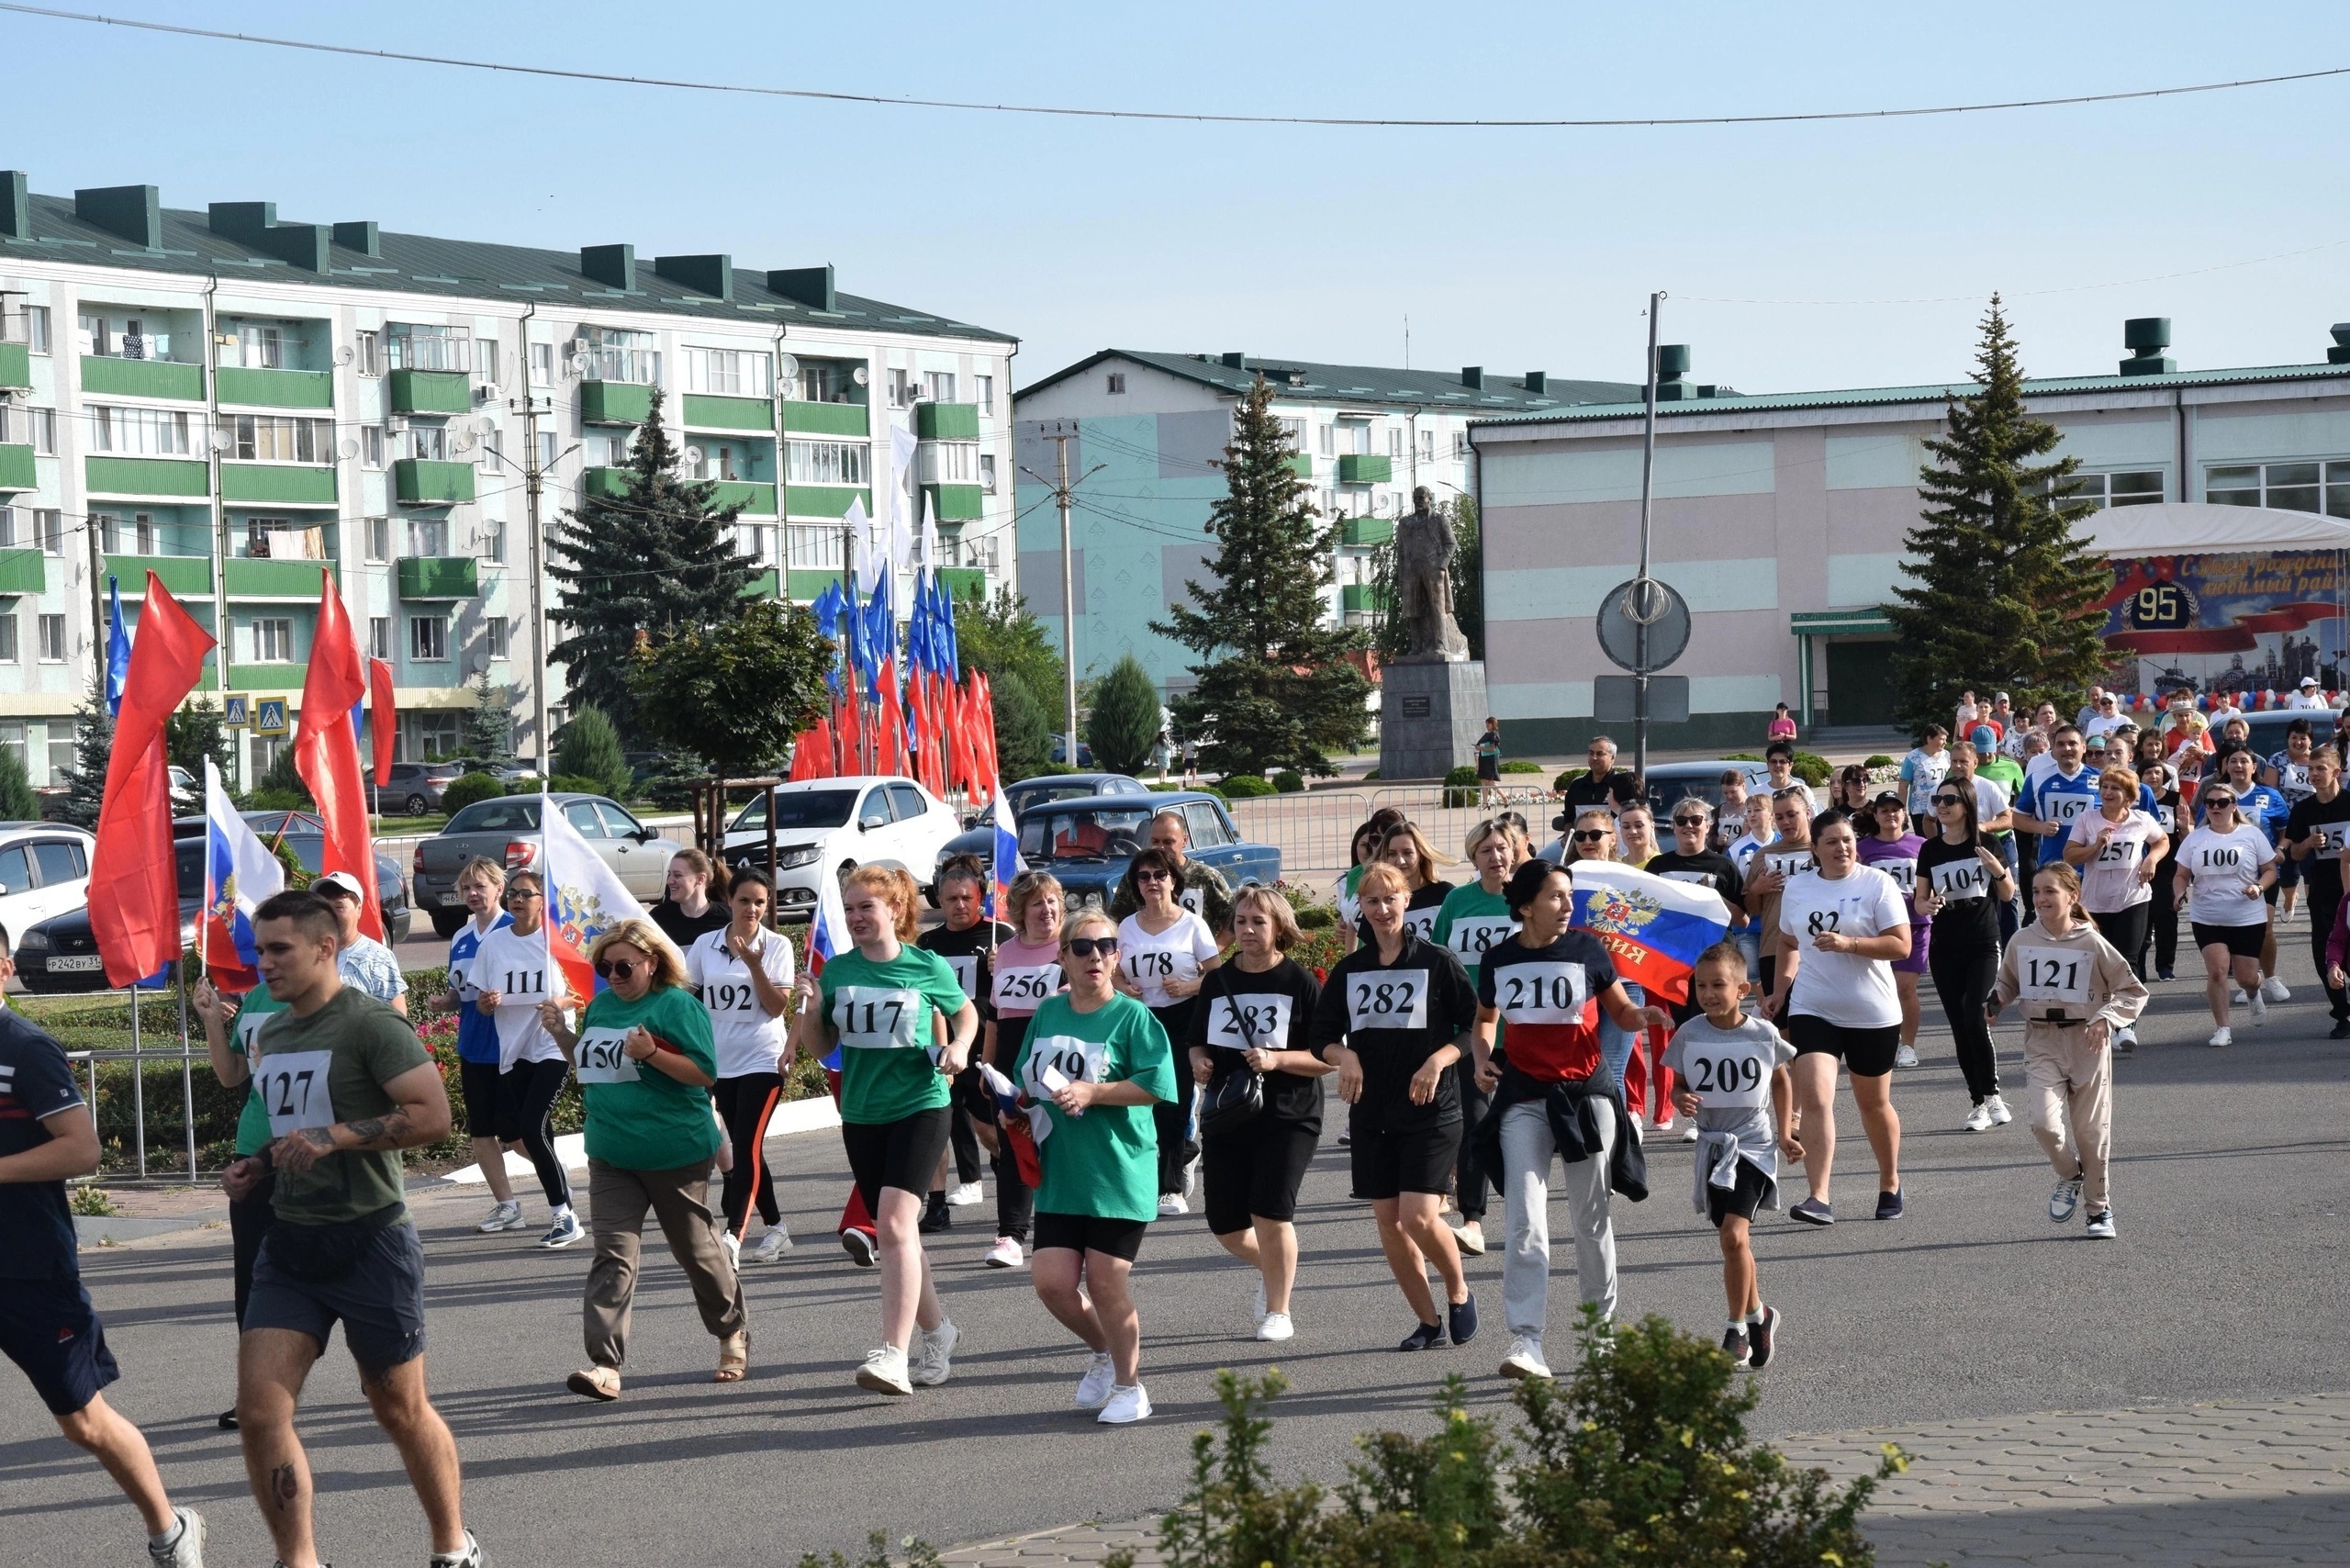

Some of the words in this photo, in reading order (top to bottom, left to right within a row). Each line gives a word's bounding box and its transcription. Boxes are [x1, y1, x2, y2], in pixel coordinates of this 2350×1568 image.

[2181, 556, 2193, 577] С
[2199, 575, 2292, 596] любимый
[2139, 588, 2177, 621] 95
[1930, 768, 1946, 780] 27
[2052, 800, 2087, 818] 167
[1724, 824, 1741, 839] 79
[2098, 842, 2135, 861] 257
[2202, 849, 2240, 867] 100
[1774, 857, 1814, 875] 114
[1879, 866, 1913, 885] 51
[1942, 866, 1984, 893] 104
[1807, 911, 1841, 936] 82
[1459, 927, 1511, 954] 187
[89, 957, 98, 966] 31
[1128, 952, 1173, 979] 178
[2028, 958, 2077, 991] 121
[505, 969, 544, 995] 111
[999, 974, 1047, 999] 256
[1505, 976, 1572, 1011] 210
[707, 984, 754, 1011] 192
[1356, 981, 1415, 1016] 282
[844, 1001, 904, 1034] 117
[1221, 1005, 1278, 1036] 283
[578, 1038, 624, 1070] 150
[1032, 1049, 1085, 1082] 149
[1695, 1057, 1762, 1092] 209
[261, 1070, 315, 1117] 127
[548, 1076, 568, 1111] SPORT
